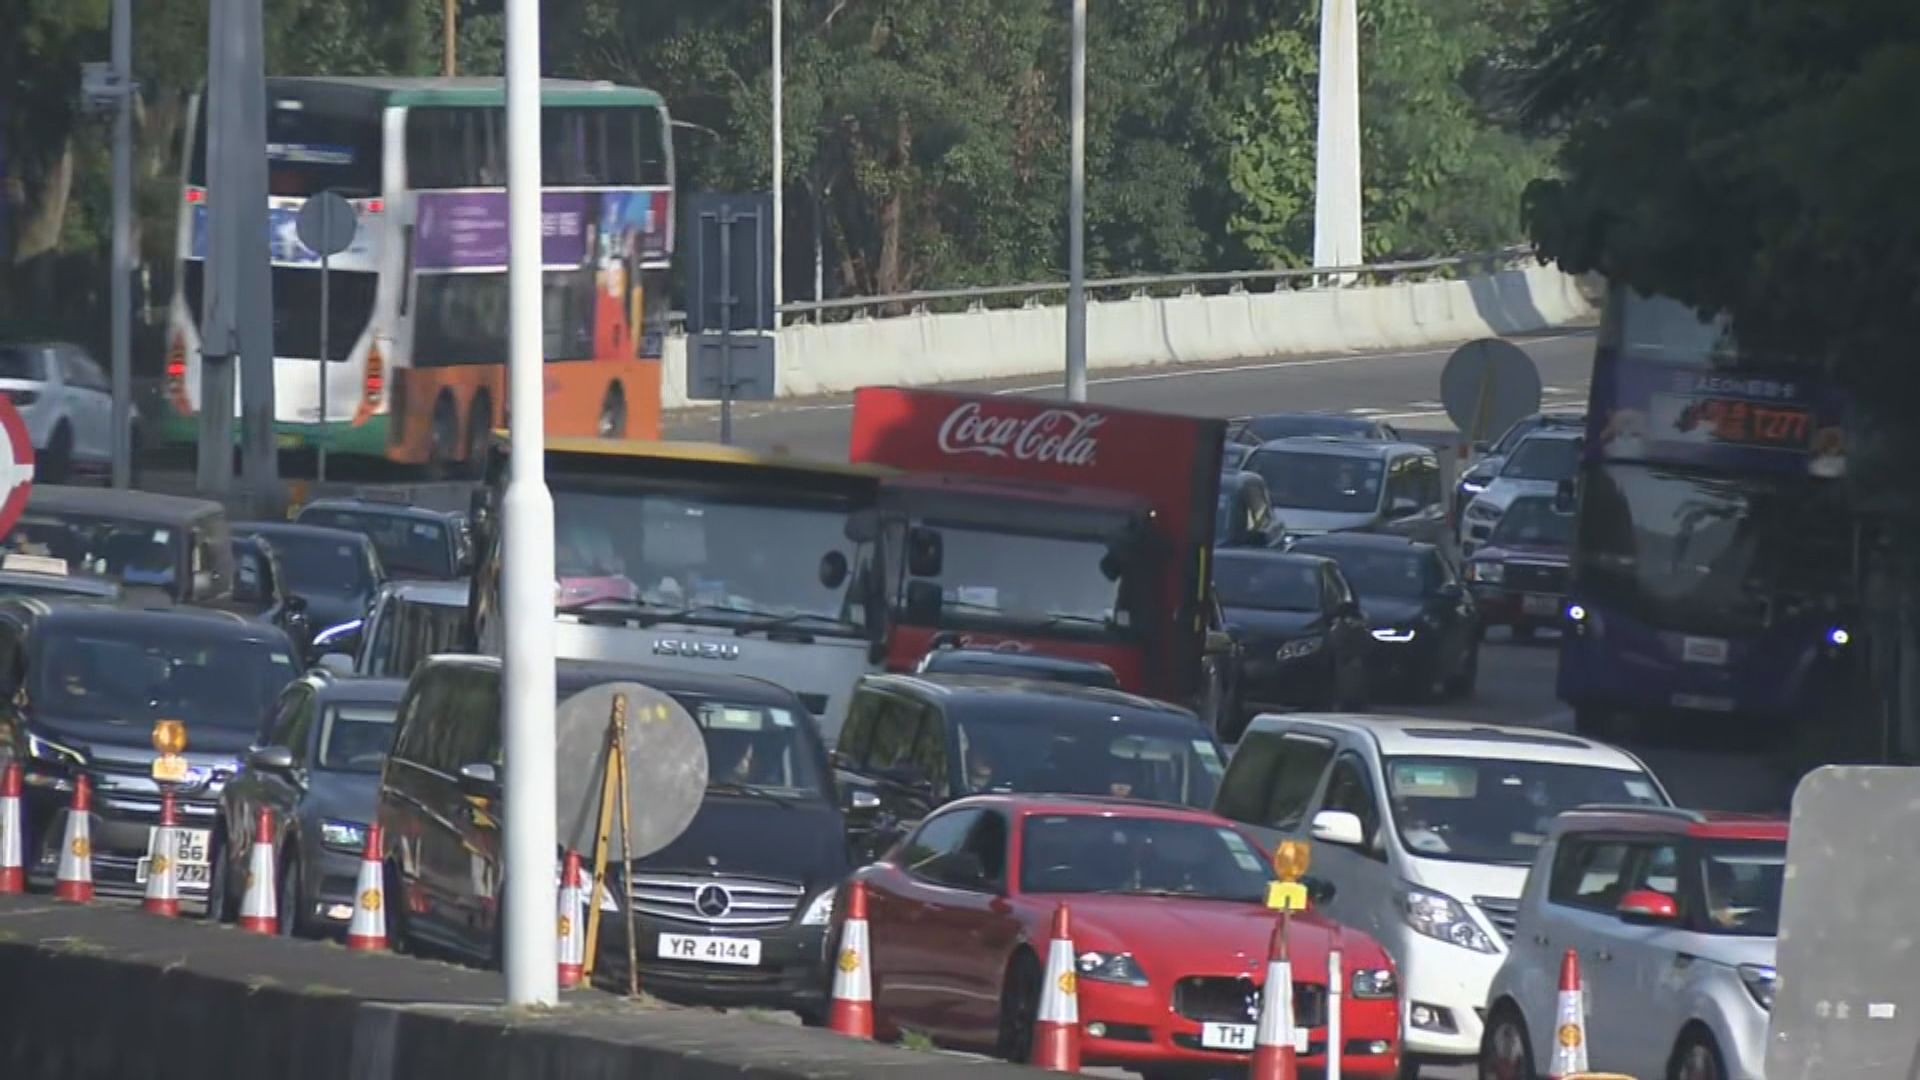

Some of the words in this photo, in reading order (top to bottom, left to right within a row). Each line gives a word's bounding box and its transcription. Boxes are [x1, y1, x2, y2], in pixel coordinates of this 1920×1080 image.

[938, 402, 1107, 465] Coca-Cola
[652, 640, 739, 660] ISUZU
[671, 938, 697, 956] YR
[706, 941, 750, 959] 4144
[1218, 1025, 1245, 1044] TH
